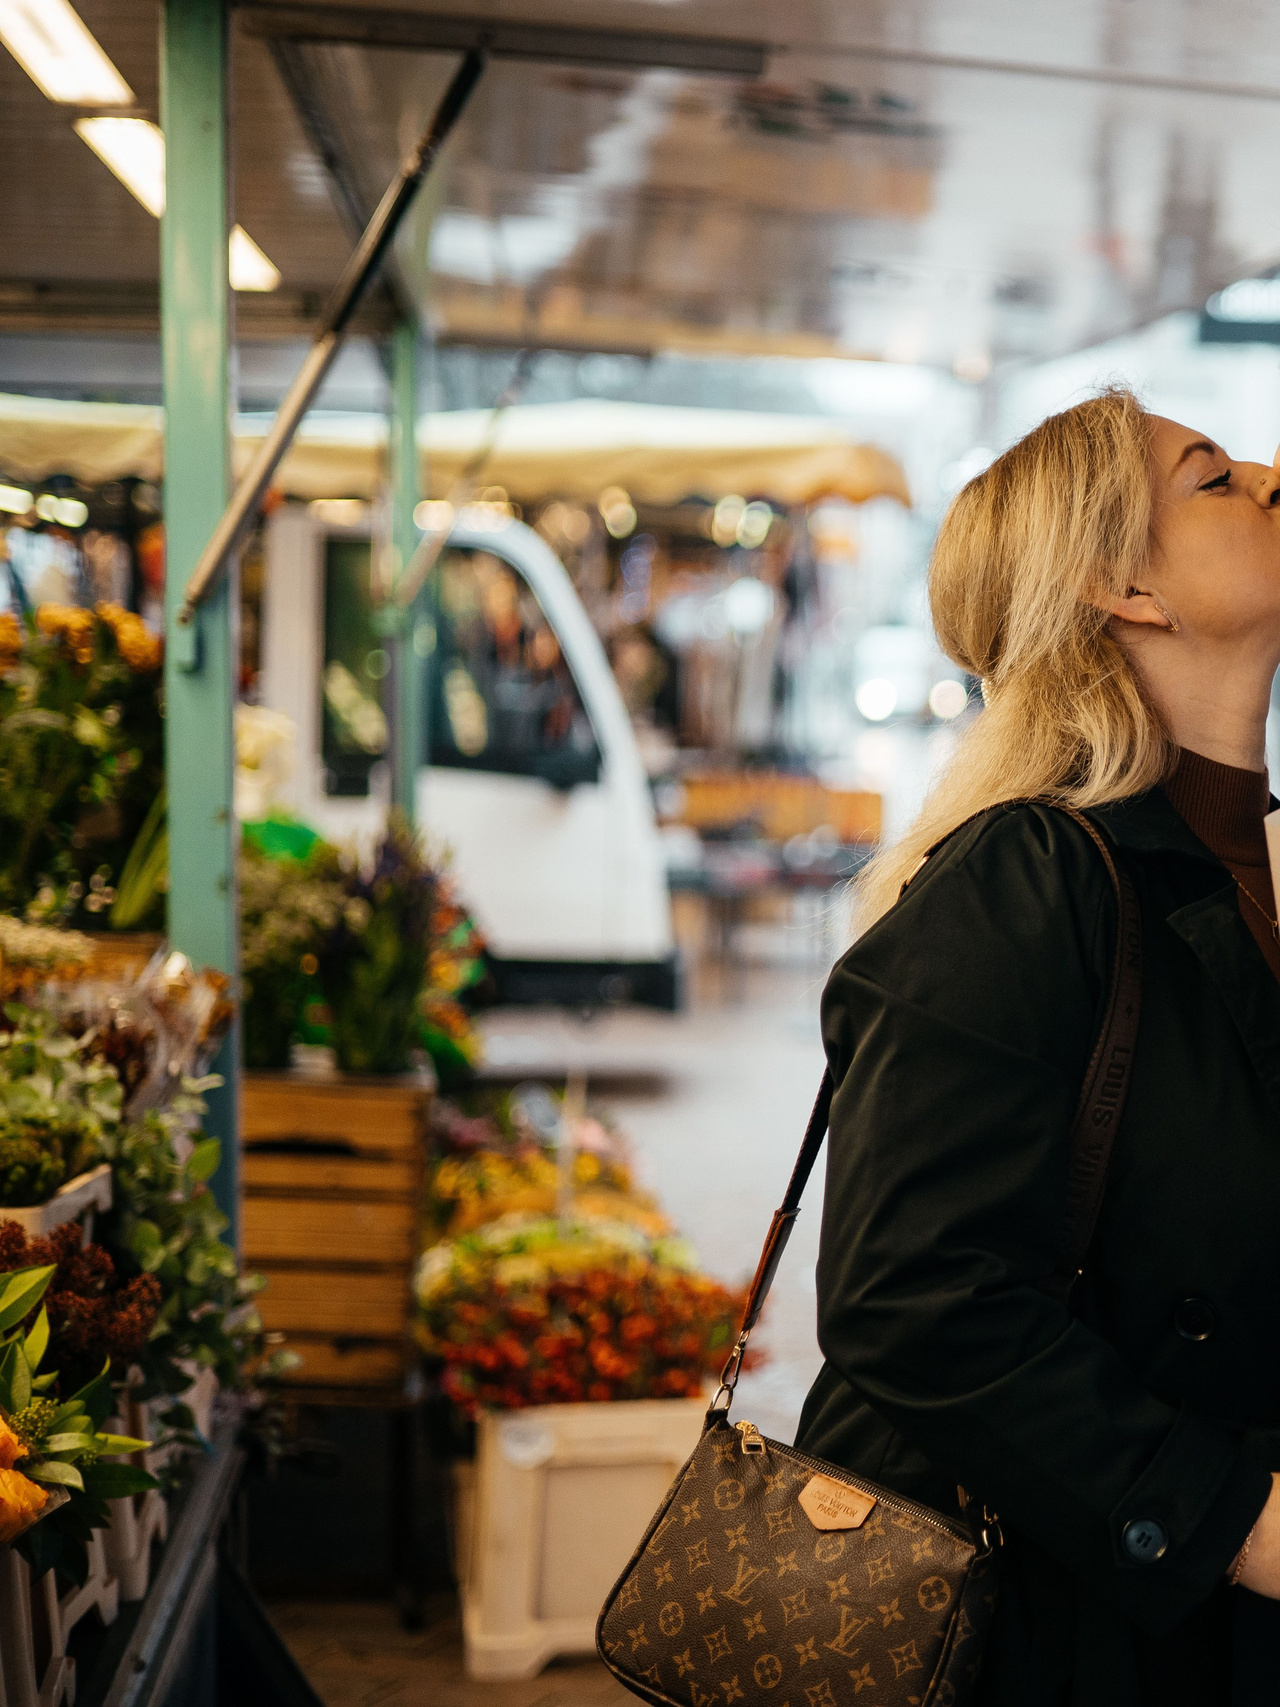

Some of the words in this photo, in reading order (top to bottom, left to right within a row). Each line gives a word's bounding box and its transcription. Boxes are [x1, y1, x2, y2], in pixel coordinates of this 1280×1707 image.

[1092, 1045, 1131, 1128] LOUIS
[816, 1502, 840, 1519] PARIS
[829, 1497, 859, 1518] VUITTON
